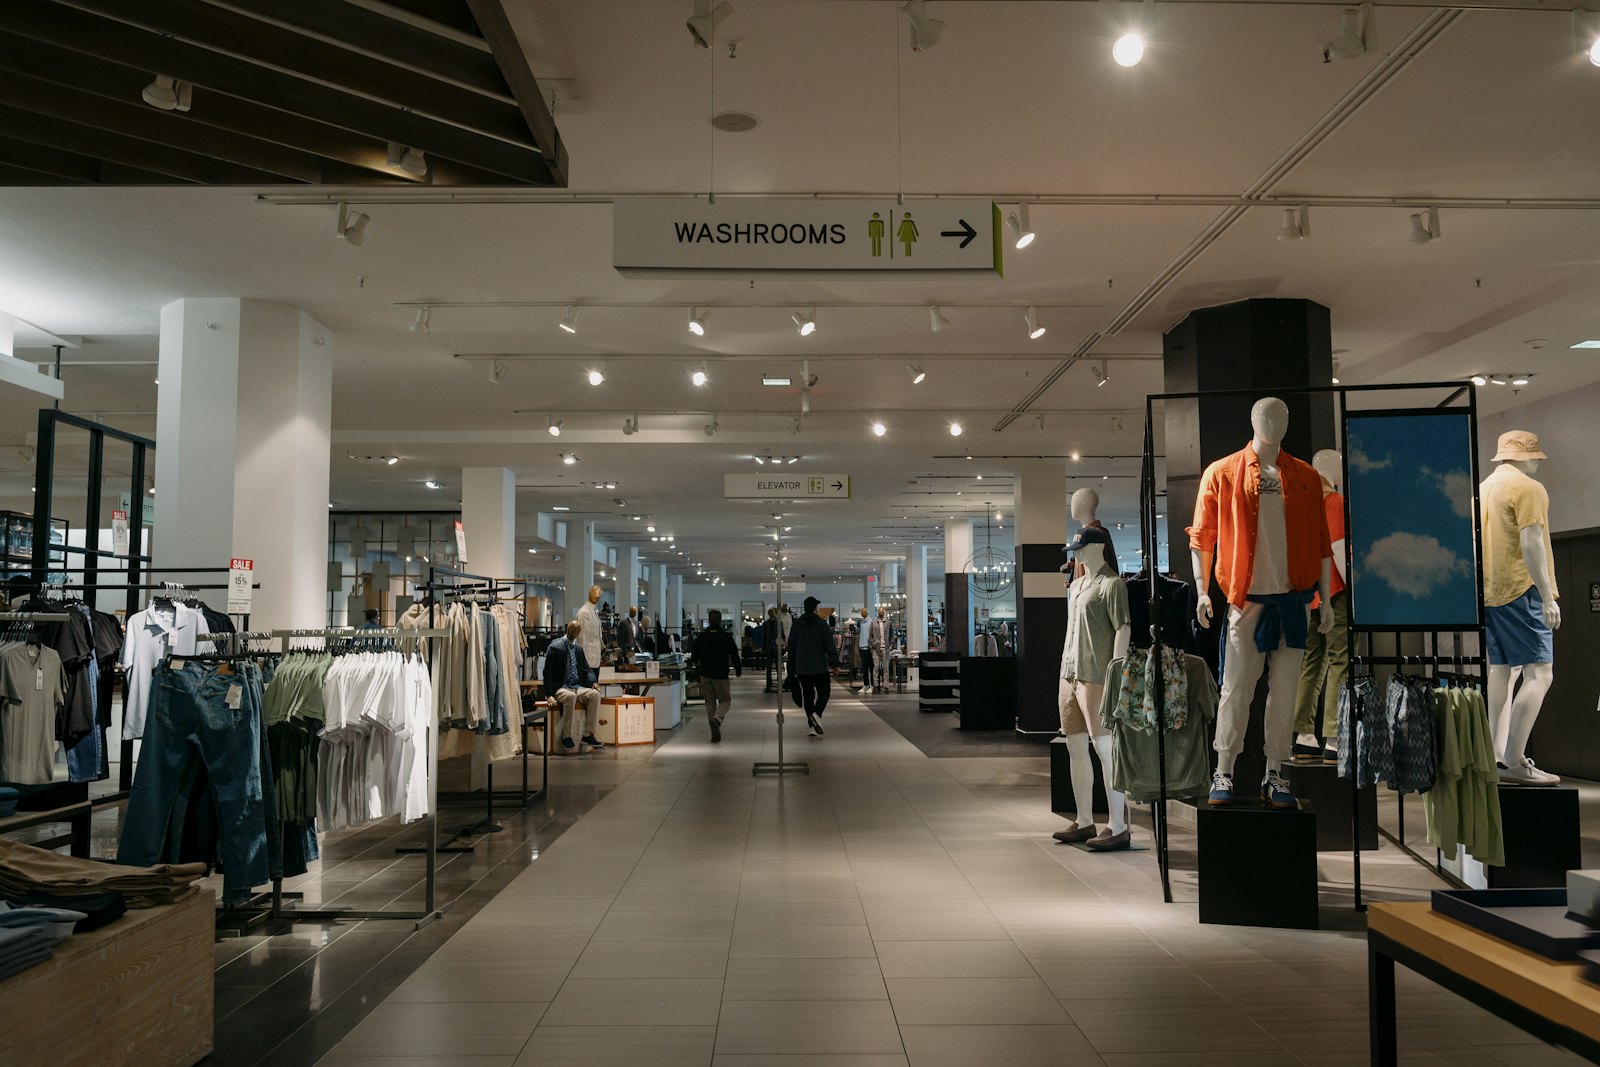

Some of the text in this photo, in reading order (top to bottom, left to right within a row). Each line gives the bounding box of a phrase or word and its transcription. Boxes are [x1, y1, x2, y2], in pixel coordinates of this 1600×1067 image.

[674, 222, 846, 244] WASHROOMS
[757, 481, 801, 490] ELEVATOR
[113, 511, 126, 520] SALE
[232, 559, 251, 570] SALE
[235, 576, 248, 586] 15%
